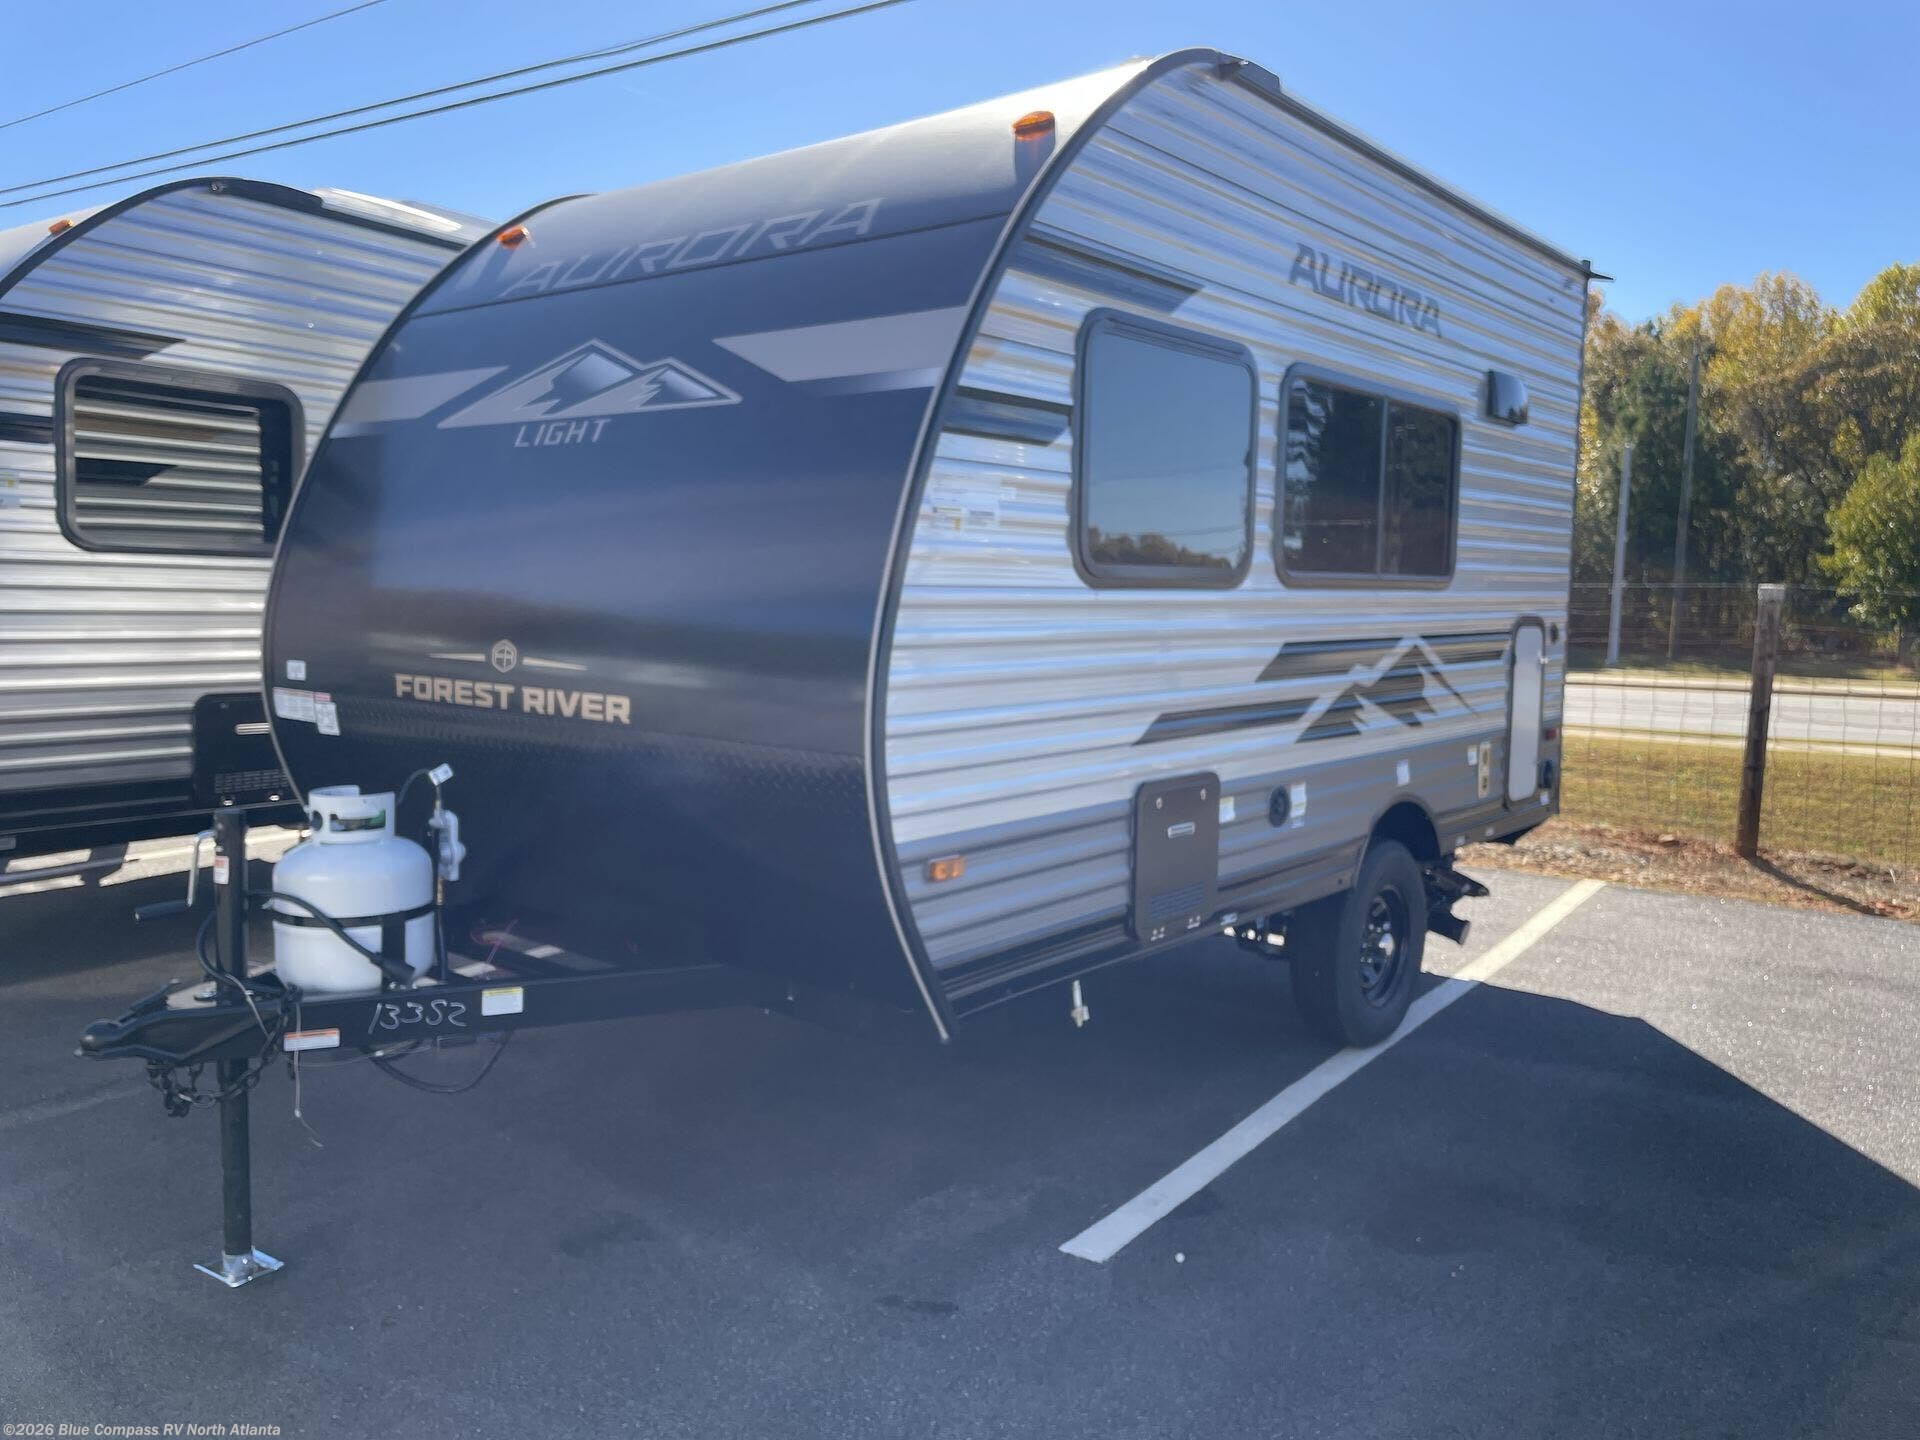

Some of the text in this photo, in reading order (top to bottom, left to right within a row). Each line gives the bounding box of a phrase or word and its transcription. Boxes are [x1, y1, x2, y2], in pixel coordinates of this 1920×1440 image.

[500, 199, 882, 297] AURORA
[1288, 242, 1443, 339] AURORA
[514, 418, 612, 448] LIGHT
[395, 673, 631, 724] FOREST RIVER
